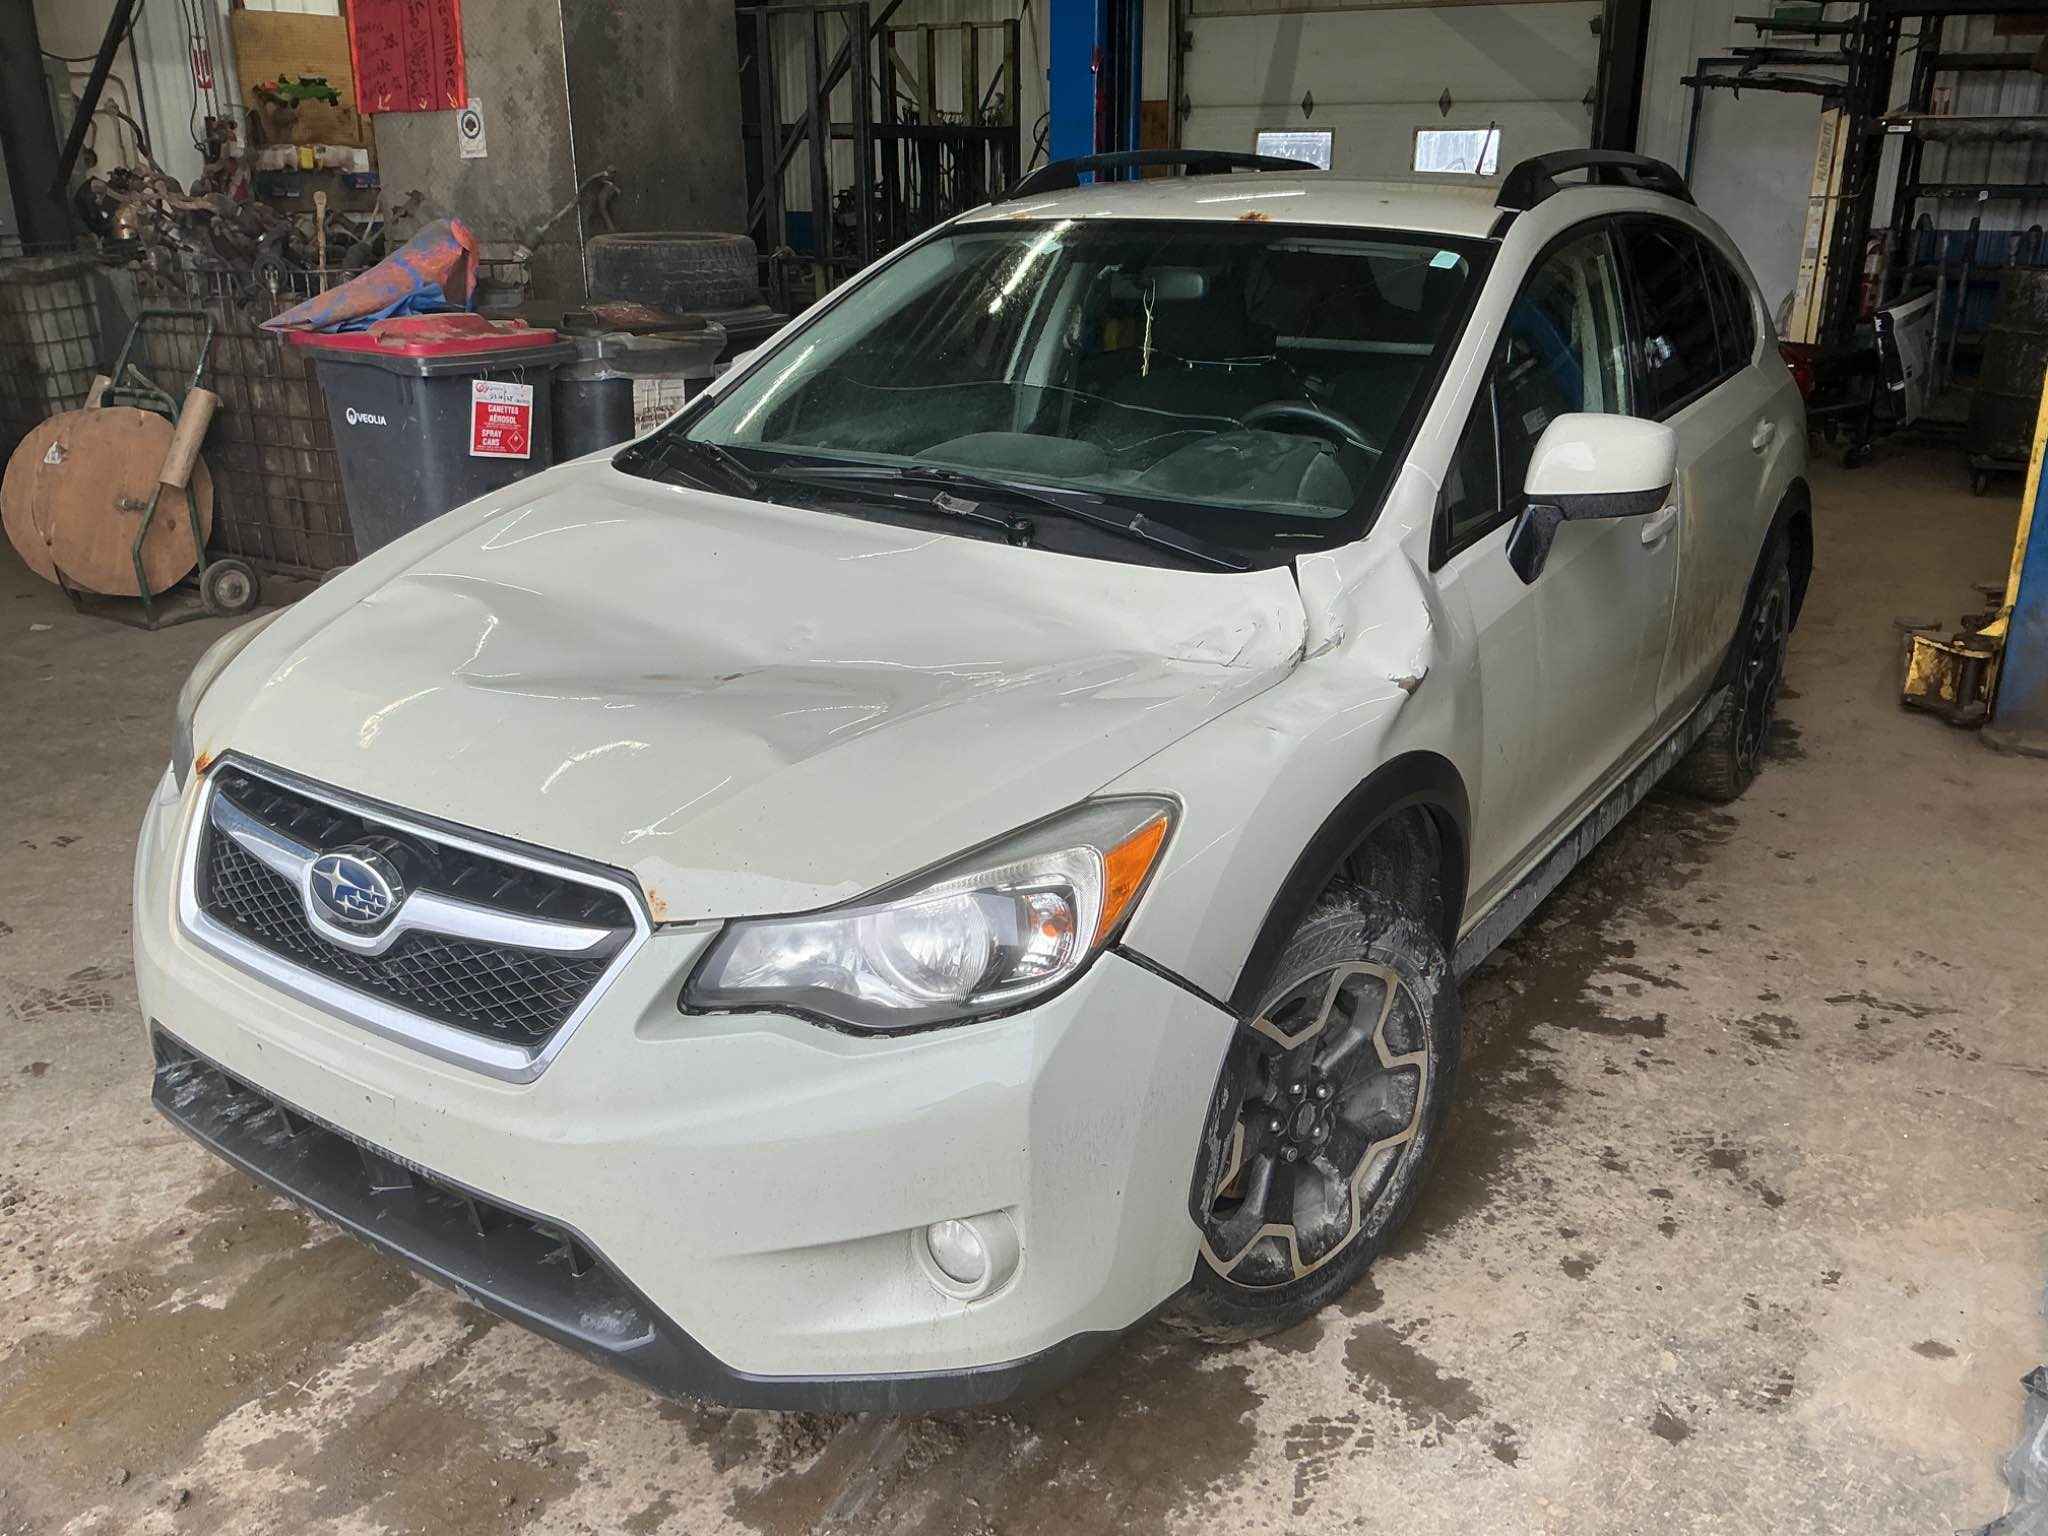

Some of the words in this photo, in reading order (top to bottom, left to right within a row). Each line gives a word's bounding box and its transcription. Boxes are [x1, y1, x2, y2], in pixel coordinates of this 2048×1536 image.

[488, 404, 519, 415] CANETTES
[355, 413, 387, 426] VEOLIA
[481, 429, 502, 438] SPRAY
[482, 437, 500, 446] CANS
